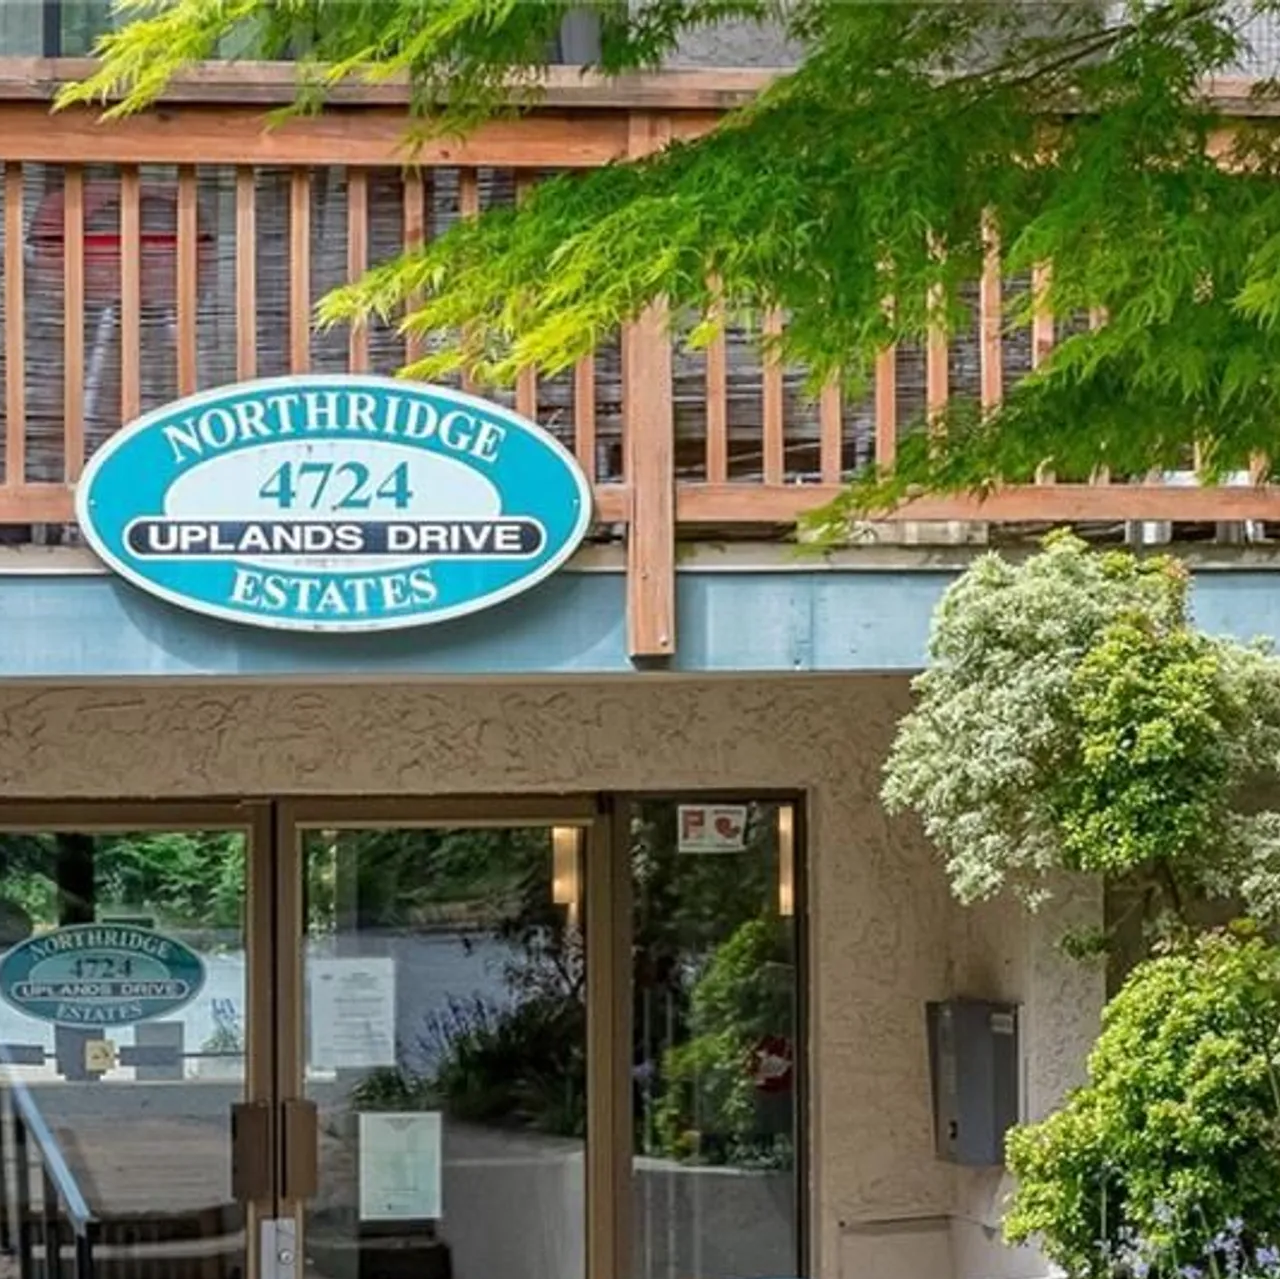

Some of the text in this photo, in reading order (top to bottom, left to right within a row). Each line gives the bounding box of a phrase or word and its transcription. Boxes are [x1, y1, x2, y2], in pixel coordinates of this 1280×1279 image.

[162, 392, 506, 464] NORTHRIDGE
[259, 460, 413, 510] 4724
[147, 523, 521, 553] UPLANDS DRIVE
[231, 568, 438, 614] ESTATES
[30, 929, 171, 960] NORTHRIDGE
[72, 958, 133, 979] 4724
[21, 984, 179, 998] UPLANDS DRIVE
[56, 1002, 143, 1021] ESTATES
